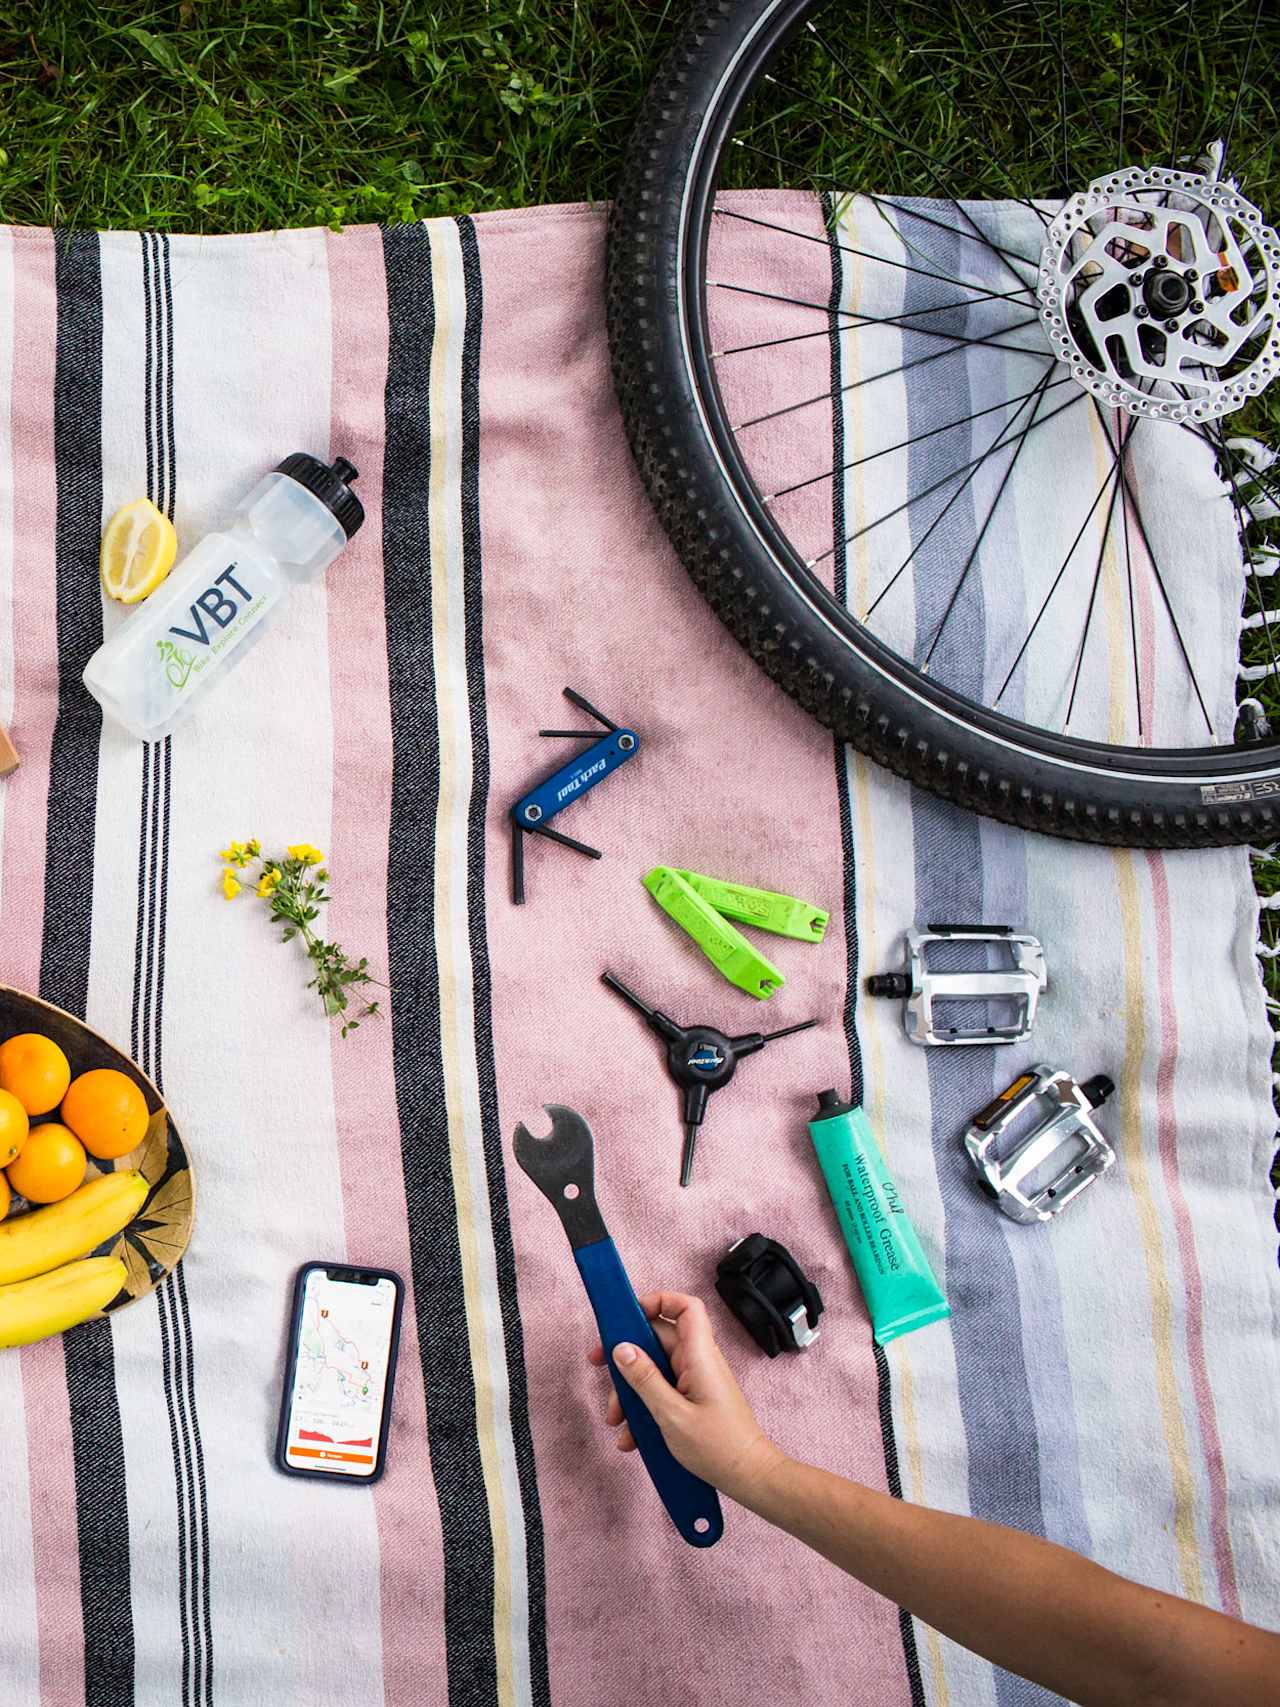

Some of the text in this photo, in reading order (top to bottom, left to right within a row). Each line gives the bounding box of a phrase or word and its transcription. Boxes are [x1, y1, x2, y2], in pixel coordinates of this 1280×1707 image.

[169, 562, 252, 646] VBT
[841, 1163, 852, 1179] FOR
[854, 1197, 864, 1213] AND
[853, 1153, 900, 1271] Waterproof Grease
